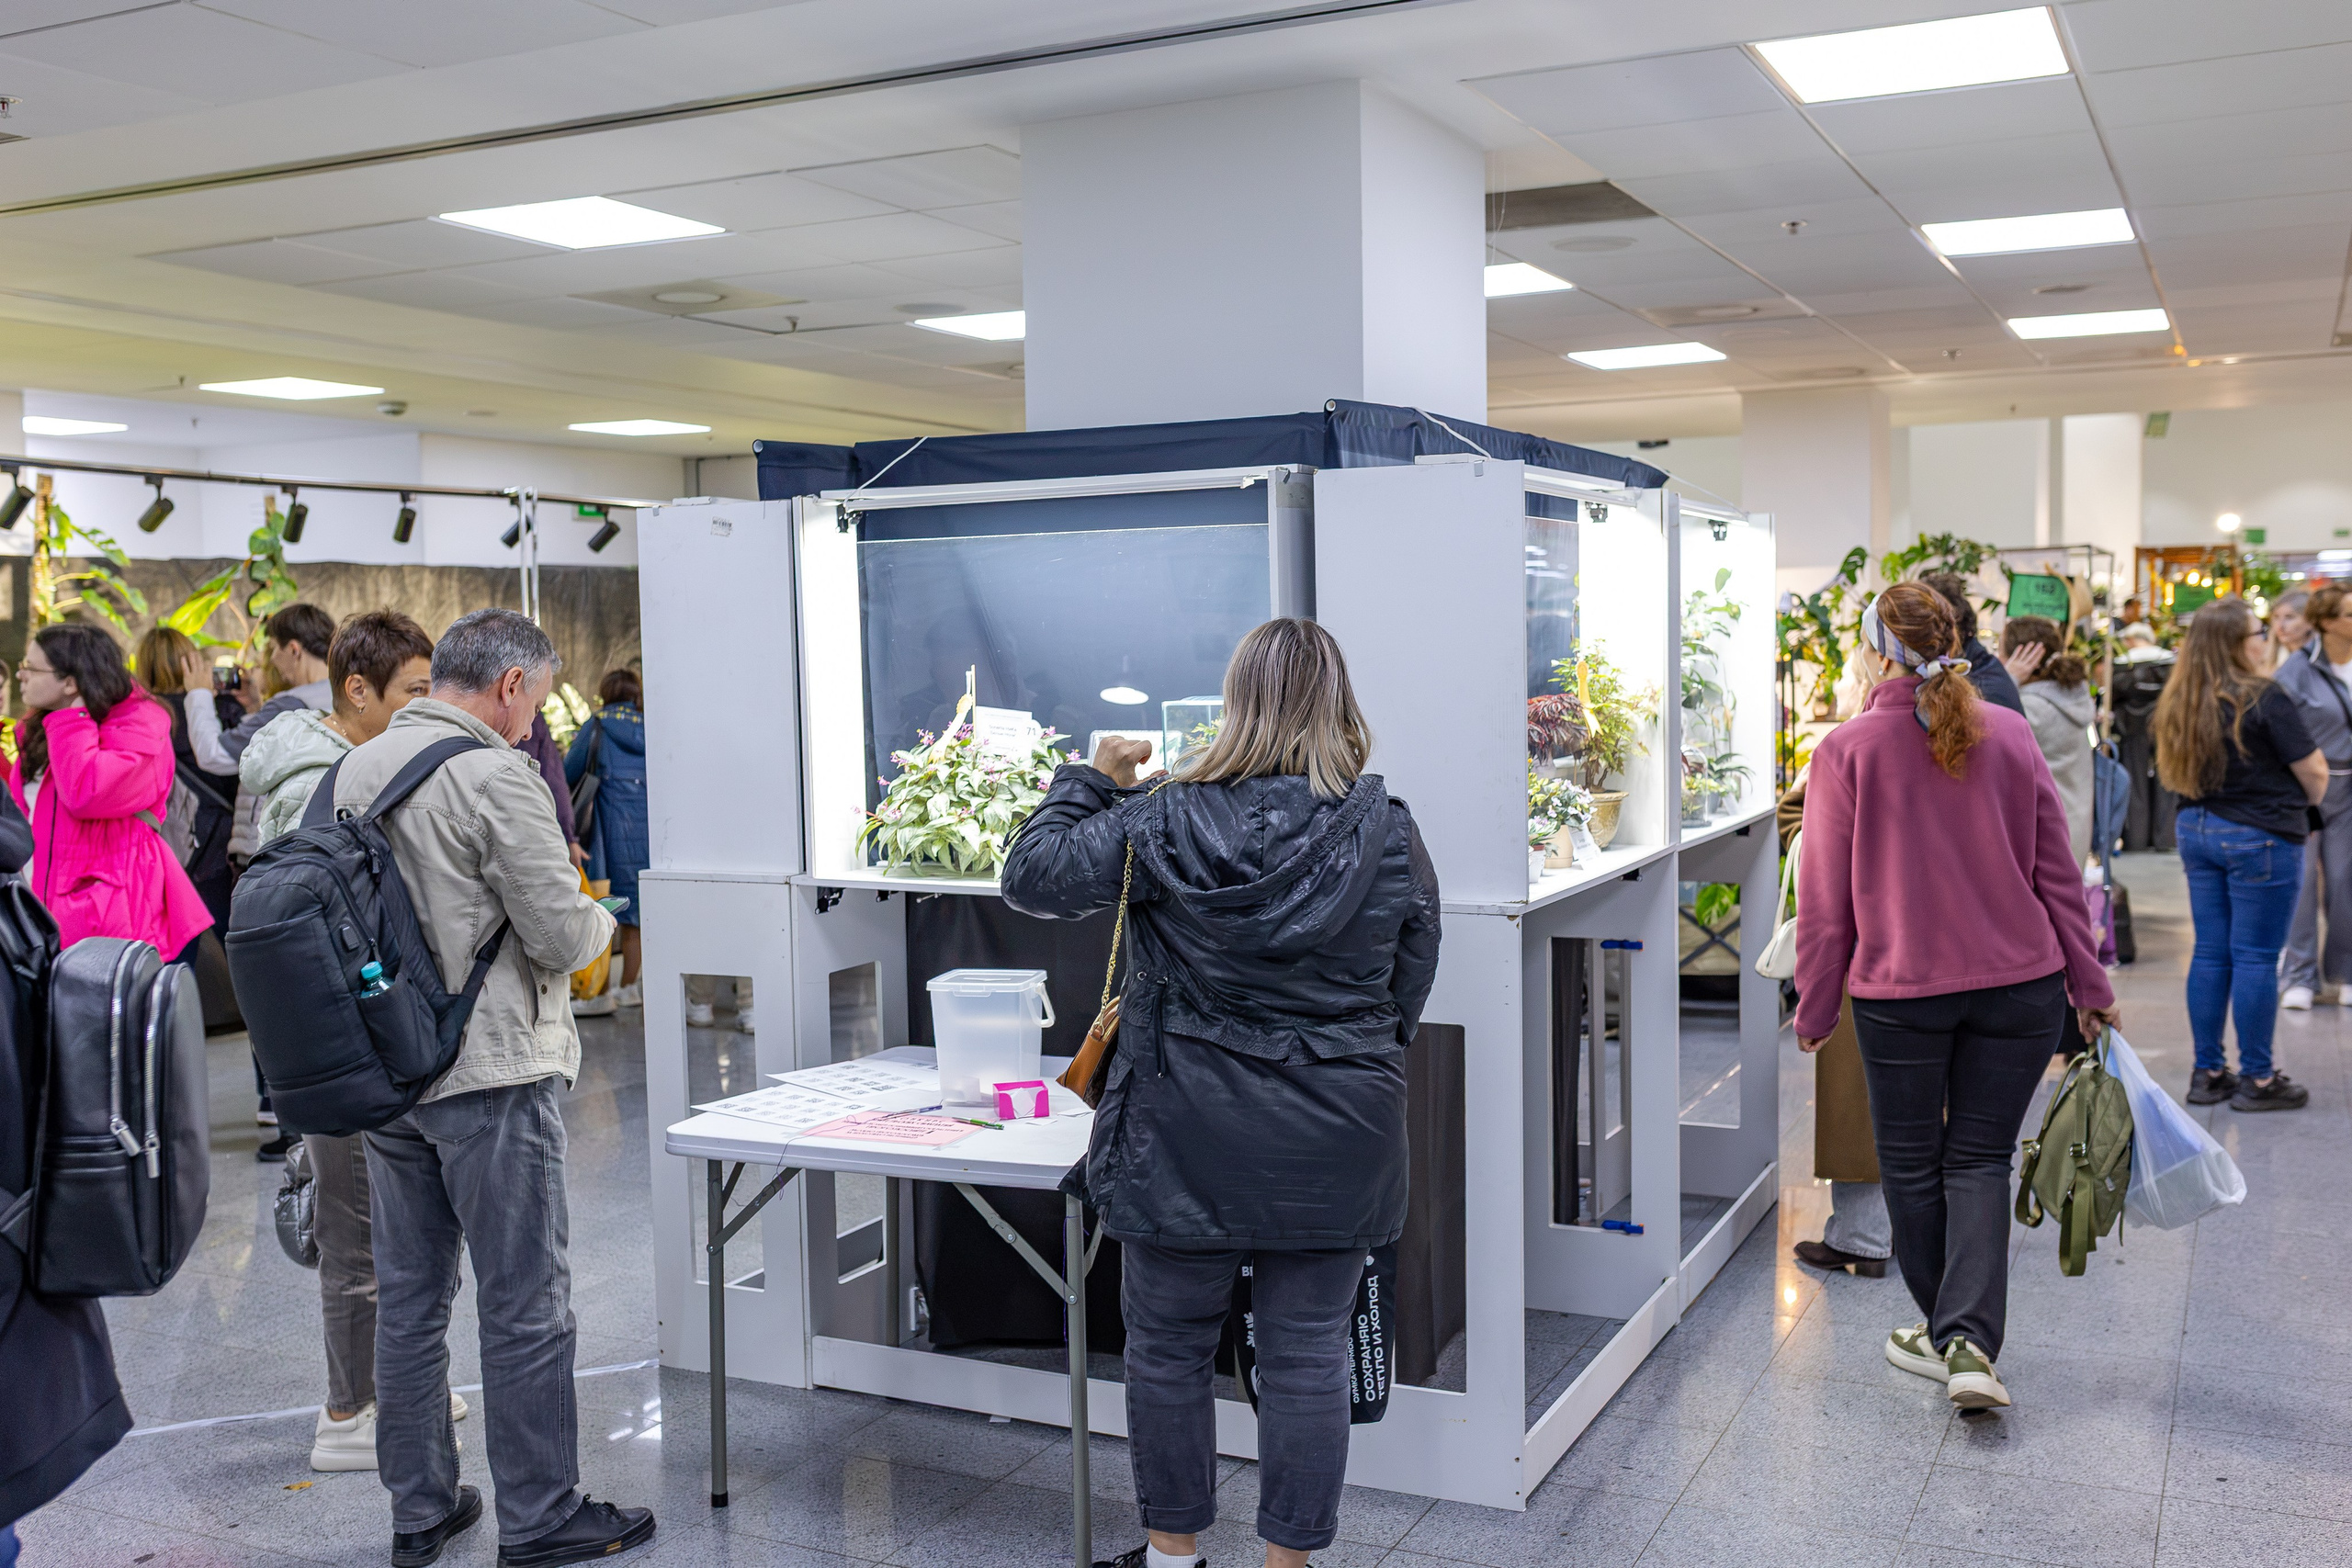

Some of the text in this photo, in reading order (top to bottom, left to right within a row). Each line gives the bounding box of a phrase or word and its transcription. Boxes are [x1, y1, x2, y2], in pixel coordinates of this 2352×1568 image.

[1026, 727, 1036, 736] 71
[1358, 1314, 1375, 1402] СОХРАНЯЮ
[1367, 1275, 1385, 1401] ТЕПЛО И ХОЛОД
